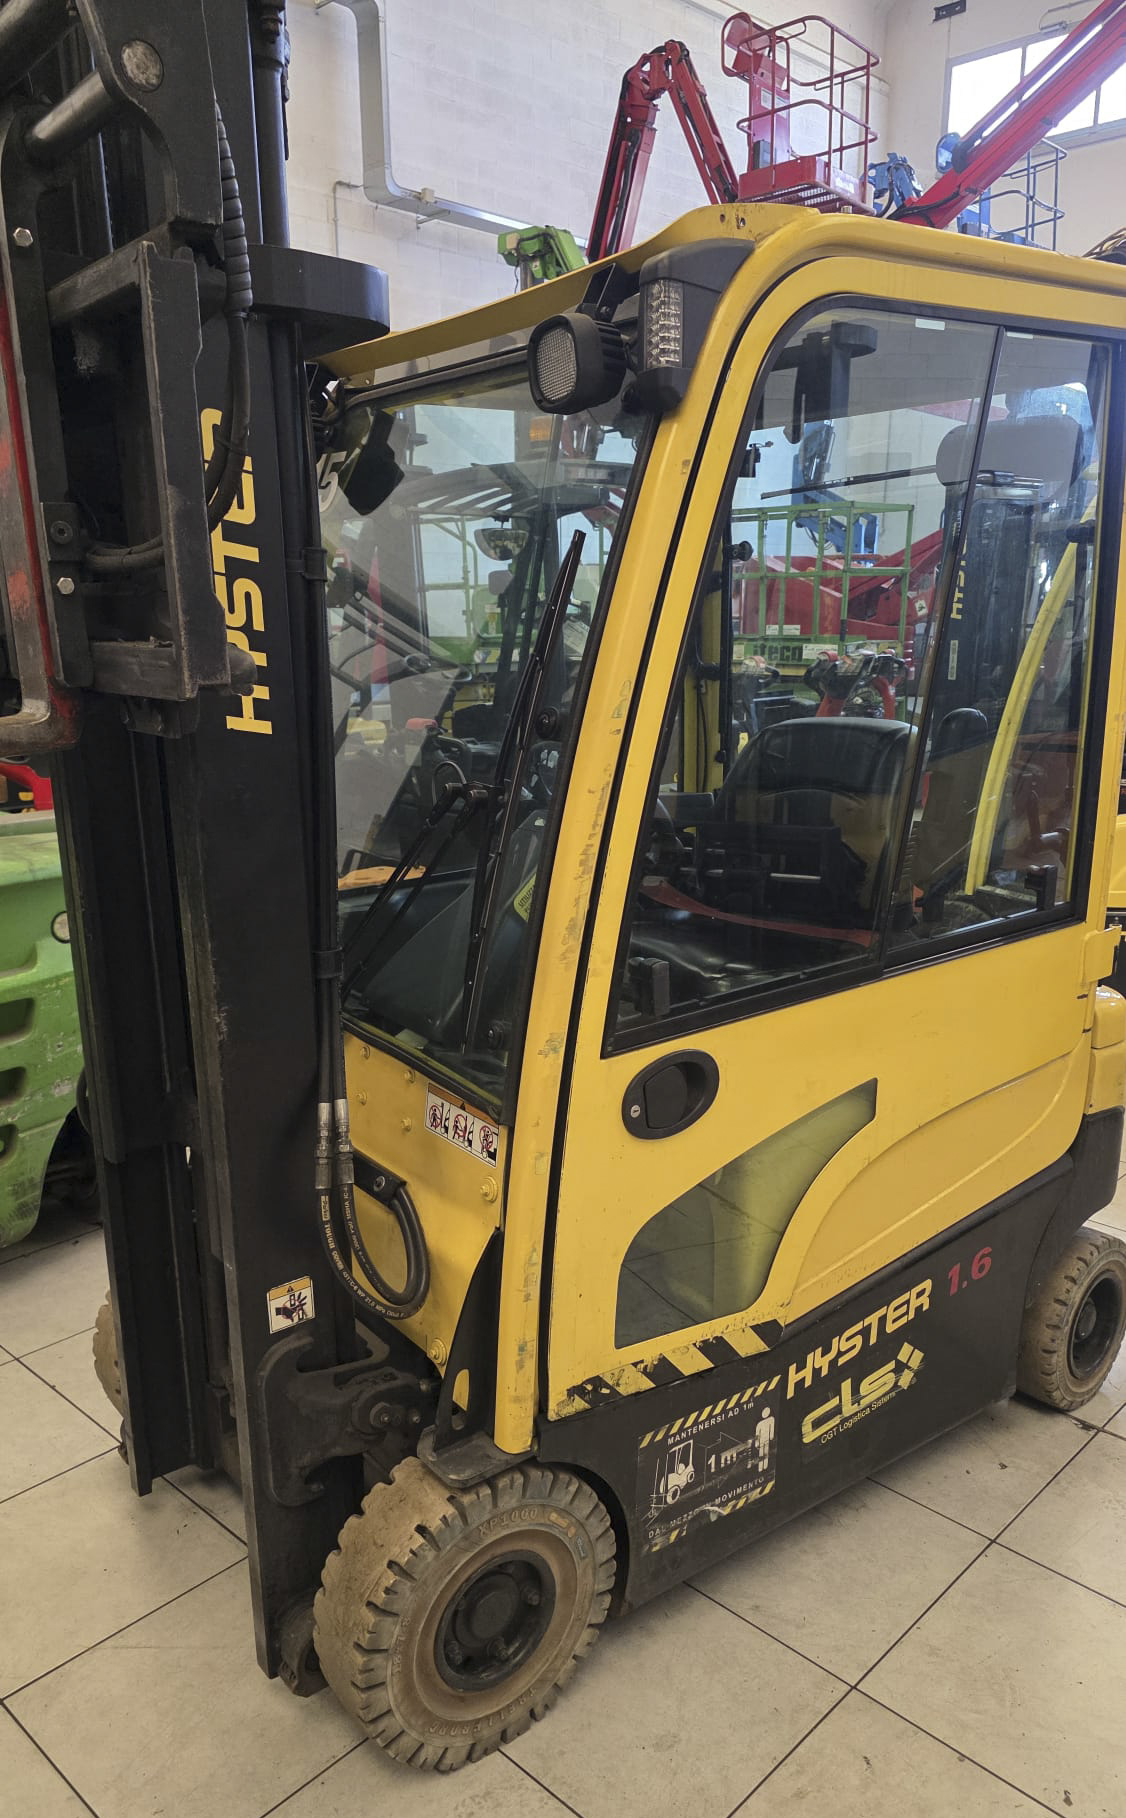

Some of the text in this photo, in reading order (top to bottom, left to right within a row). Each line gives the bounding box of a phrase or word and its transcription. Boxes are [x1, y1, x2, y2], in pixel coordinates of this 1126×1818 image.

[948, 1246, 993, 1297] 1.6
[786, 1278, 932, 1400] HYSTER
[667, 1400, 755, 1446] MANTENERSI AD 1m
[820, 1428, 838, 1444] CGT
[838, 1406, 871, 1432] Logistica
[715, 1476, 766, 1505] MOVIMENTO
